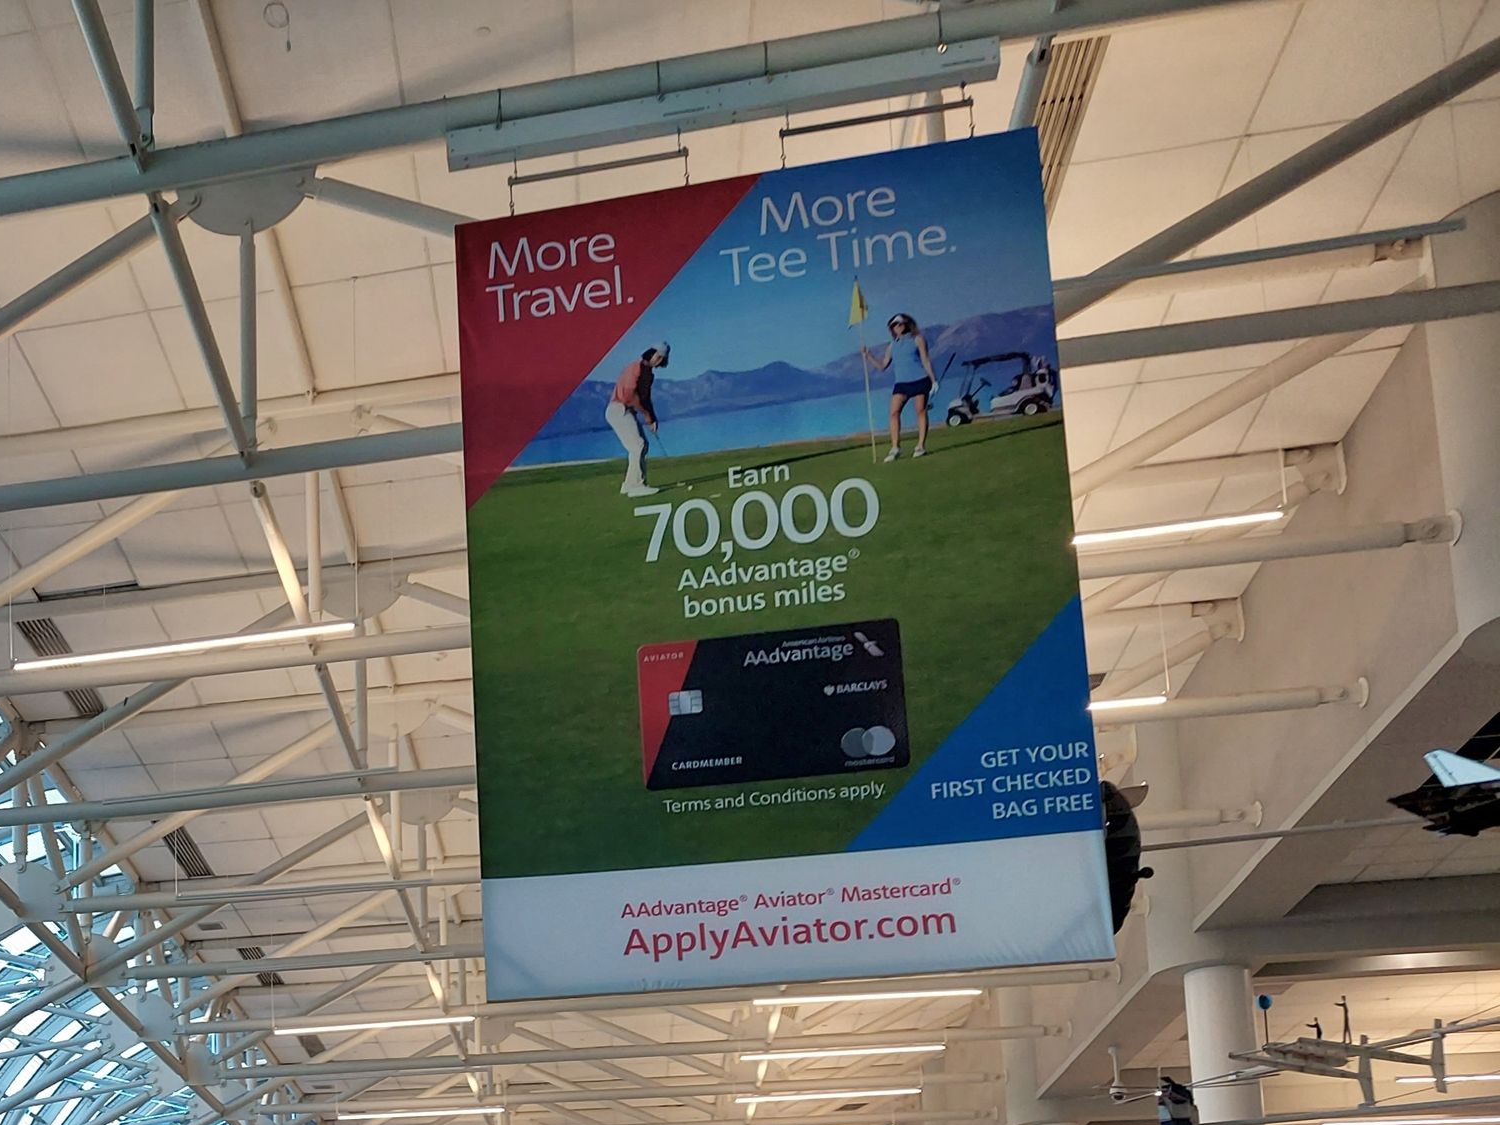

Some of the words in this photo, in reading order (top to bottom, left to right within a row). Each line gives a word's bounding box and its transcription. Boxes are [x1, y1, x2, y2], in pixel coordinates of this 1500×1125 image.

[759, 186, 897, 236] More
[485, 232, 617, 280] More
[719, 244, 808, 287] Tee
[816, 224, 958, 272] Time.
[484, 265, 635, 323] Travel.
[727, 463, 791, 489] Earn
[633, 477, 880, 563] 70,000
[683, 590, 766, 619] bonus
[774, 580, 846, 608] miles
[643, 651, 685, 663] AVIATOR
[743, 642, 854, 668] AAdvantage
[835, 679, 889, 695] BARCLAYS
[671, 756, 743, 771] CARDMEMBER
[844, 756, 896, 767] mastercard
[980, 748, 1021, 769] GET
[1025, 741, 1090, 764] YOUR
[662, 797, 712, 814] Terms
[714, 792, 746, 810] and
[749, 785, 837, 807] Conditions
[839, 780, 887, 803] apply.
[930, 777, 987, 800] FIRST
[991, 767, 1092, 793] CHECKED
[992, 798, 1039, 821] BAG
[1043, 793, 1095, 815] FREE
[623, 911, 958, 963] ApplyAviator.com
